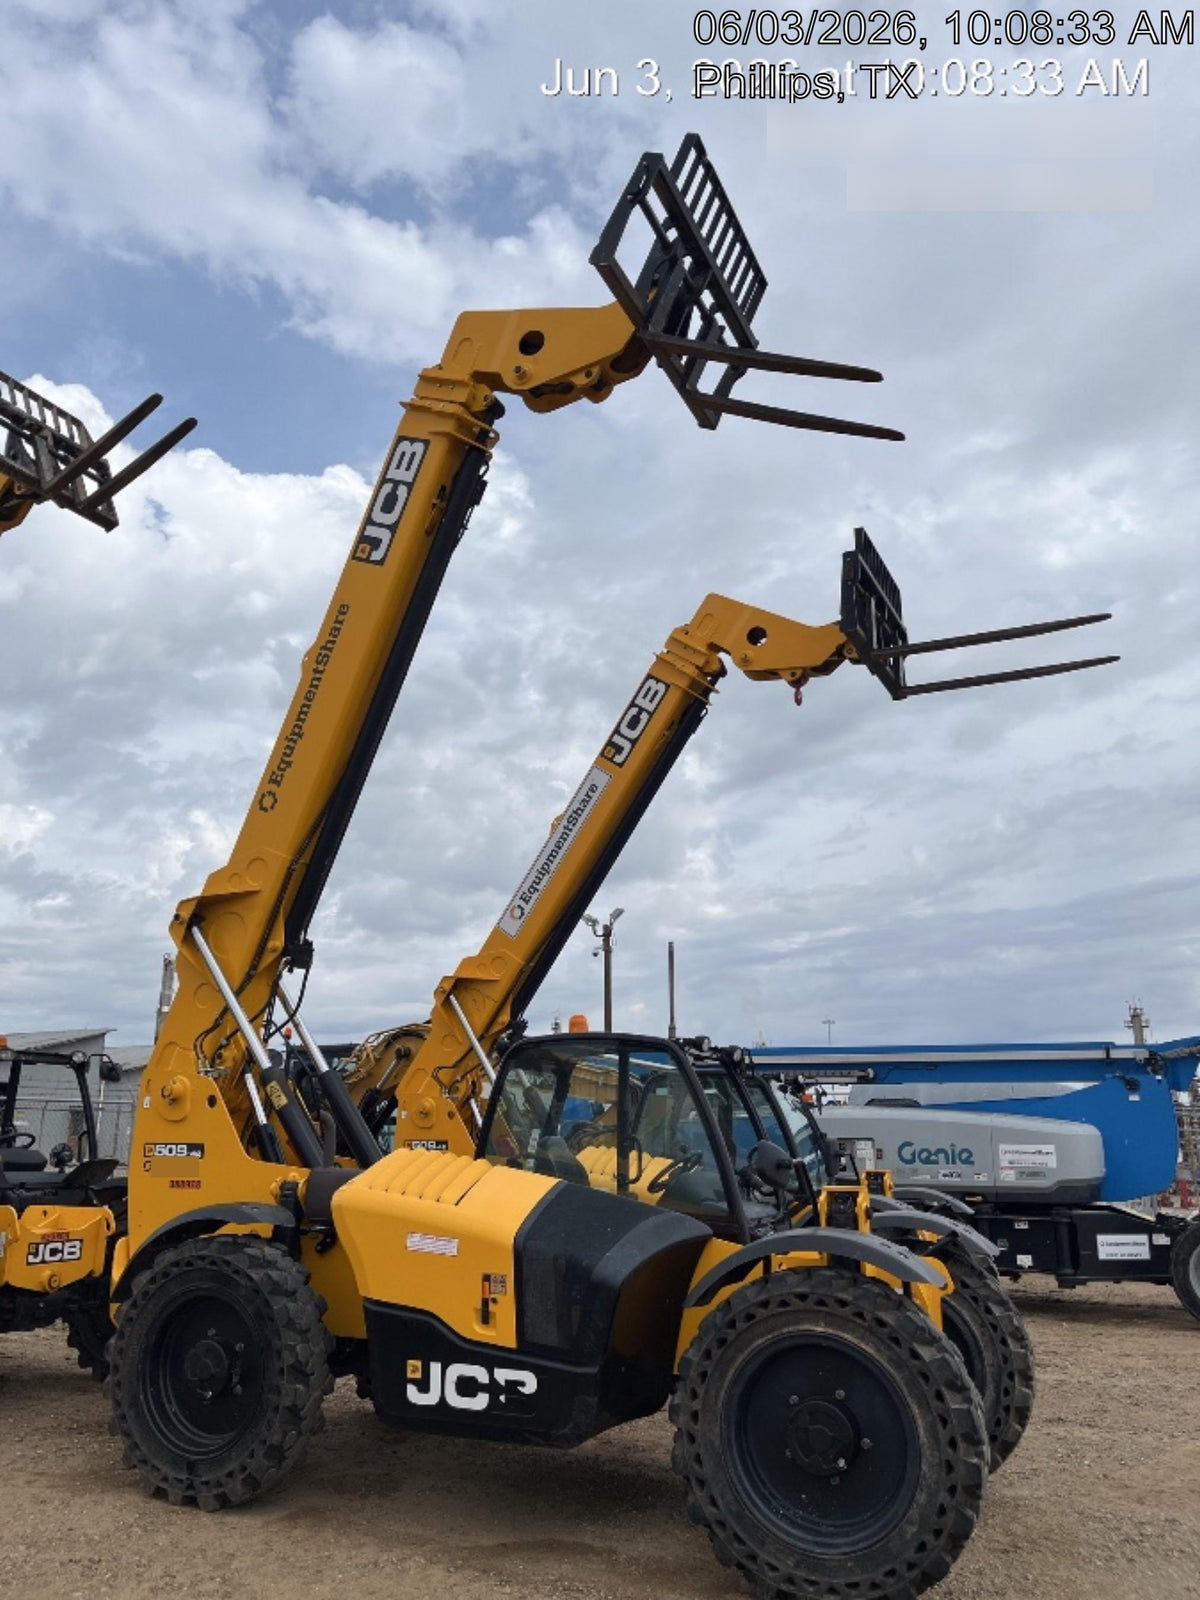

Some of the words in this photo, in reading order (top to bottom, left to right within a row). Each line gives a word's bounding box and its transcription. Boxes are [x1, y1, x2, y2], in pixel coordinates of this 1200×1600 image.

[363, 440, 426, 561] JCB
[269, 603, 350, 788] EquipmentShare
[613, 677, 668, 766] JCB
[519, 783, 599, 906] EquipmentShare
[897, 1141, 976, 1166] Genie
[27, 1241, 81, 1263] JCB
